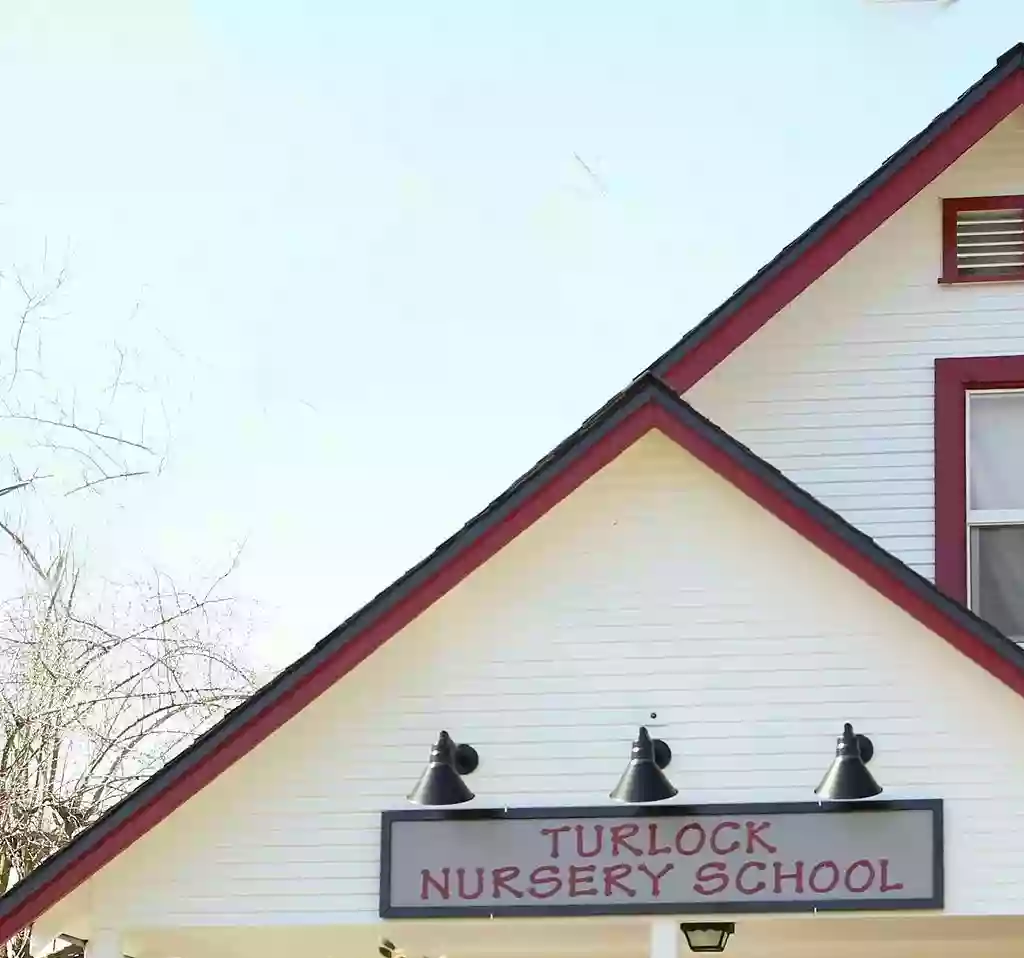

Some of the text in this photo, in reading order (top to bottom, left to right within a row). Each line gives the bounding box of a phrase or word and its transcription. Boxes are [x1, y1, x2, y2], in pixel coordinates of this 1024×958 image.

[541, 821, 777, 857] TURLOCK
[420, 859, 904, 900] NURSERY SCHOOL
